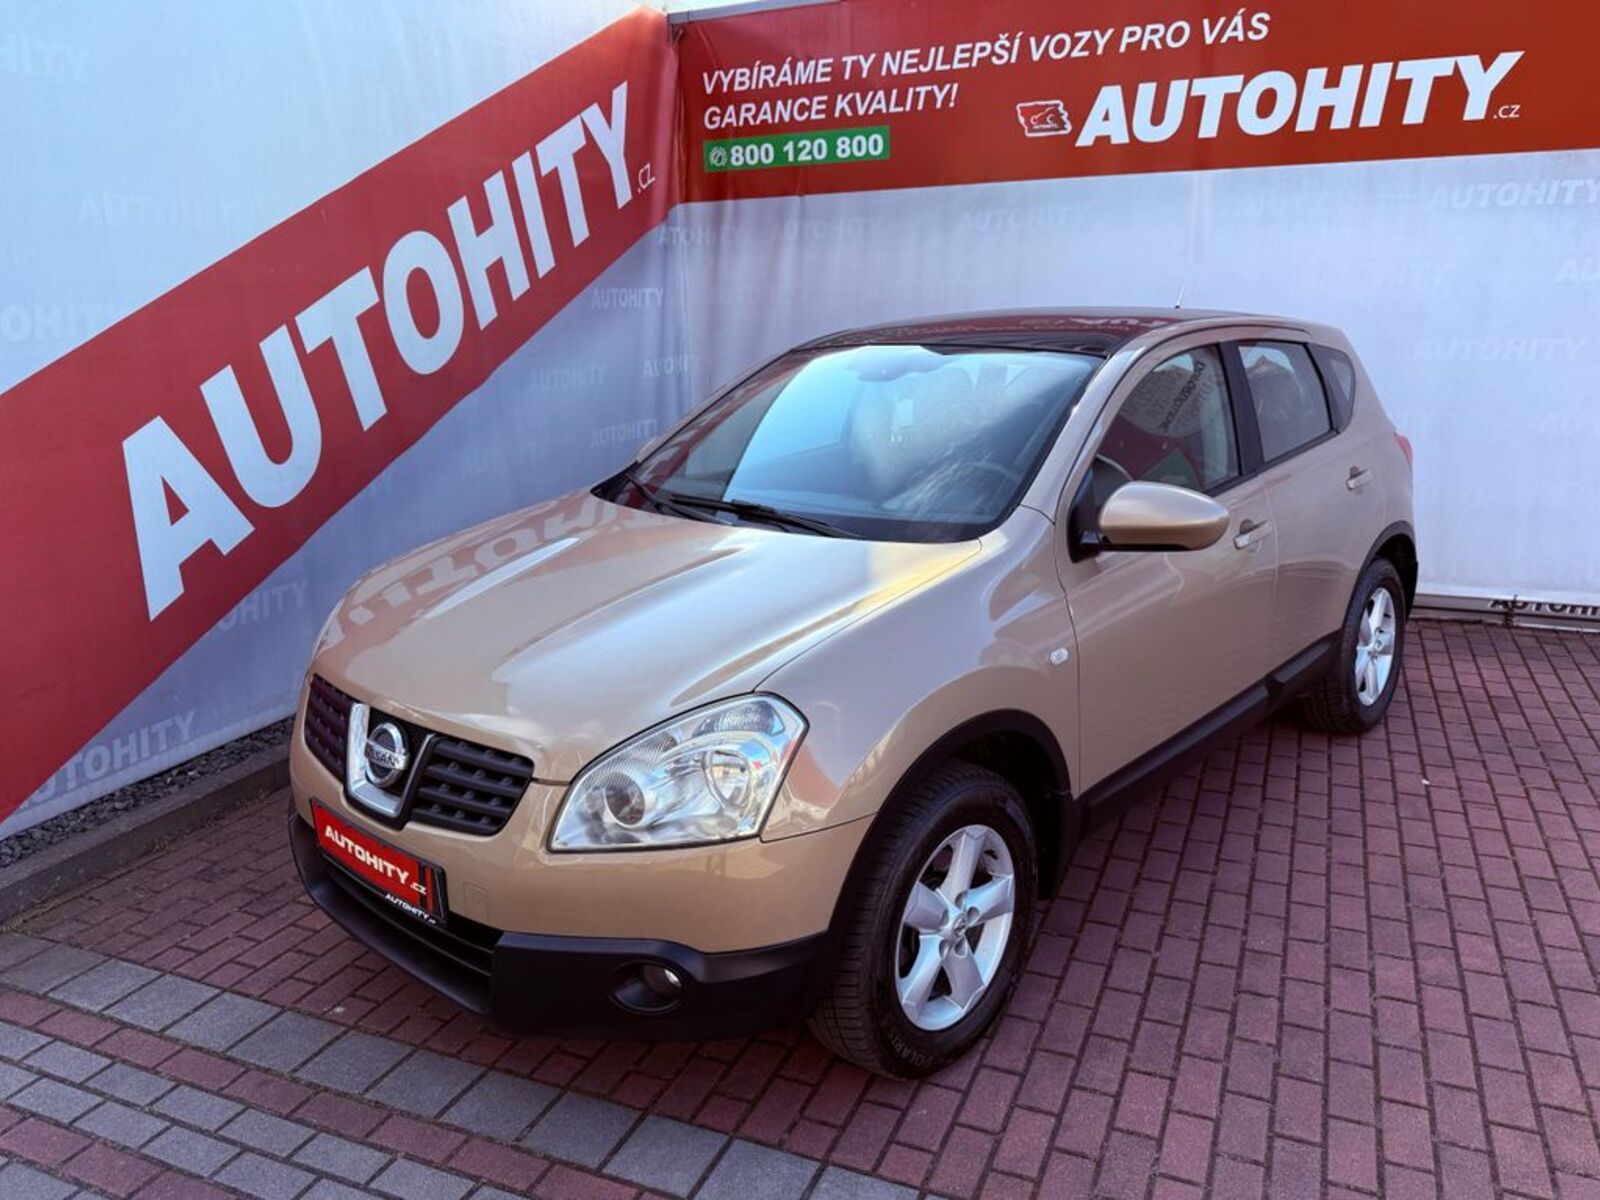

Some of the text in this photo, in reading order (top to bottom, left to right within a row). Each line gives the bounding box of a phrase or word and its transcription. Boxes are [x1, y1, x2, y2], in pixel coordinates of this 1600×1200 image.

[703, 7, 1271, 95] VYBÍRÁME TY NEJLEPŠÍ VOZY PRO VÁS
[703, 83, 958, 130] GARANCE KVALITY!
[1075, 50, 1525, 147] AUTOHITY
[730, 133, 884, 167] 800 120 800
[122, 81, 633, 621] AUTOHITY
